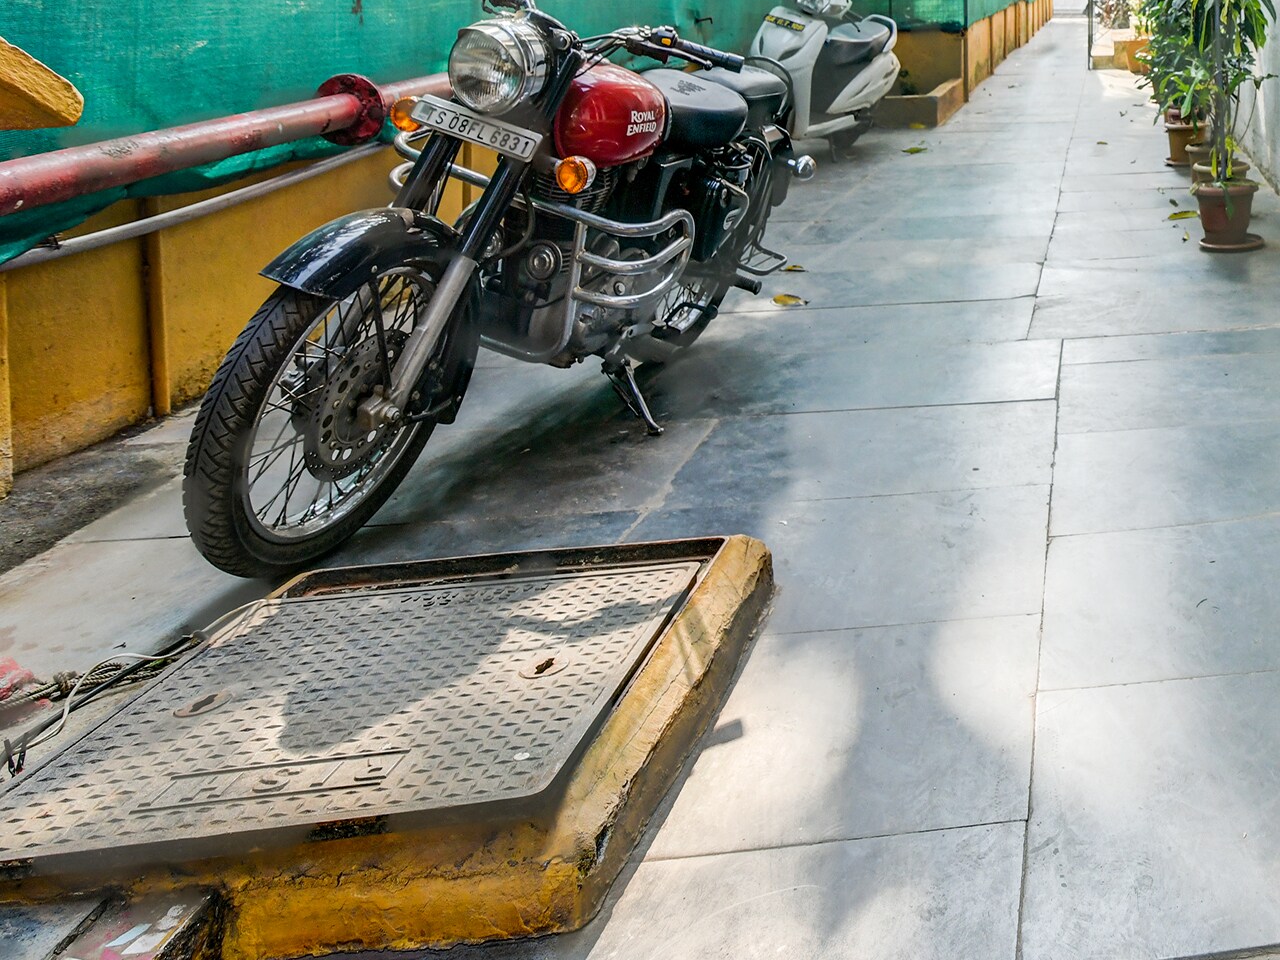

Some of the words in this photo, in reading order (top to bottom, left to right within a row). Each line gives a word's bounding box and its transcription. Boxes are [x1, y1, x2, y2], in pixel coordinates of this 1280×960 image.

[631, 110, 655, 123] ROYAL
[426, 106, 447, 125] TS
[448, 116, 484, 140] 08FL
[490, 130, 530, 155] 6831
[626, 121, 657, 136] ENFIELD
